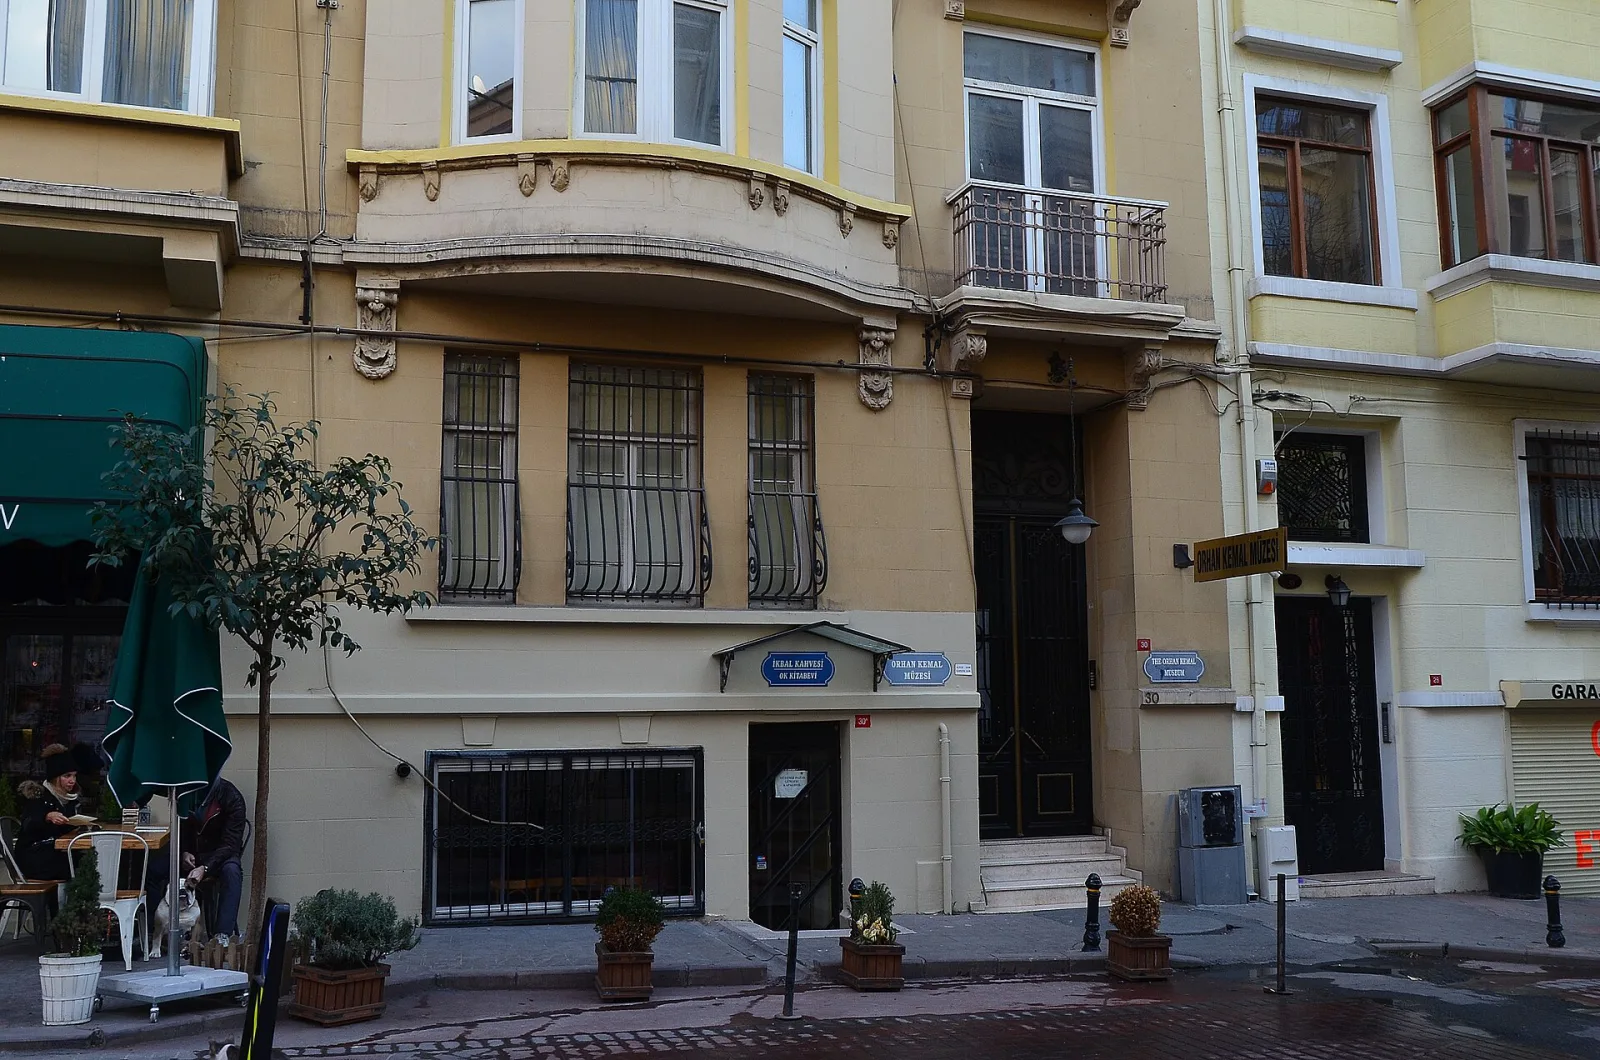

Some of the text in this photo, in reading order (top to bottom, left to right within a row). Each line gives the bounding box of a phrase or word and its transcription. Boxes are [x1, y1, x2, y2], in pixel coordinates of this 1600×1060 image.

[1197, 532, 1279, 574] ORHAN KEMAL MÜZESİ
[772, 658, 824, 668] İKBAL KAHVESİ
[891, 660, 944, 668] ORHAN KEMAL
[1151, 657, 1197, 665] THE ORHAN KEMAL
[779, 671, 818, 680] OK KİTABEVİ
[904, 670, 931, 680] MÜZESİ
[1164, 669, 1185, 677] MUSEUM
[1551, 683, 1600, 700] GARA
[1145, 692, 1160, 704] 30
